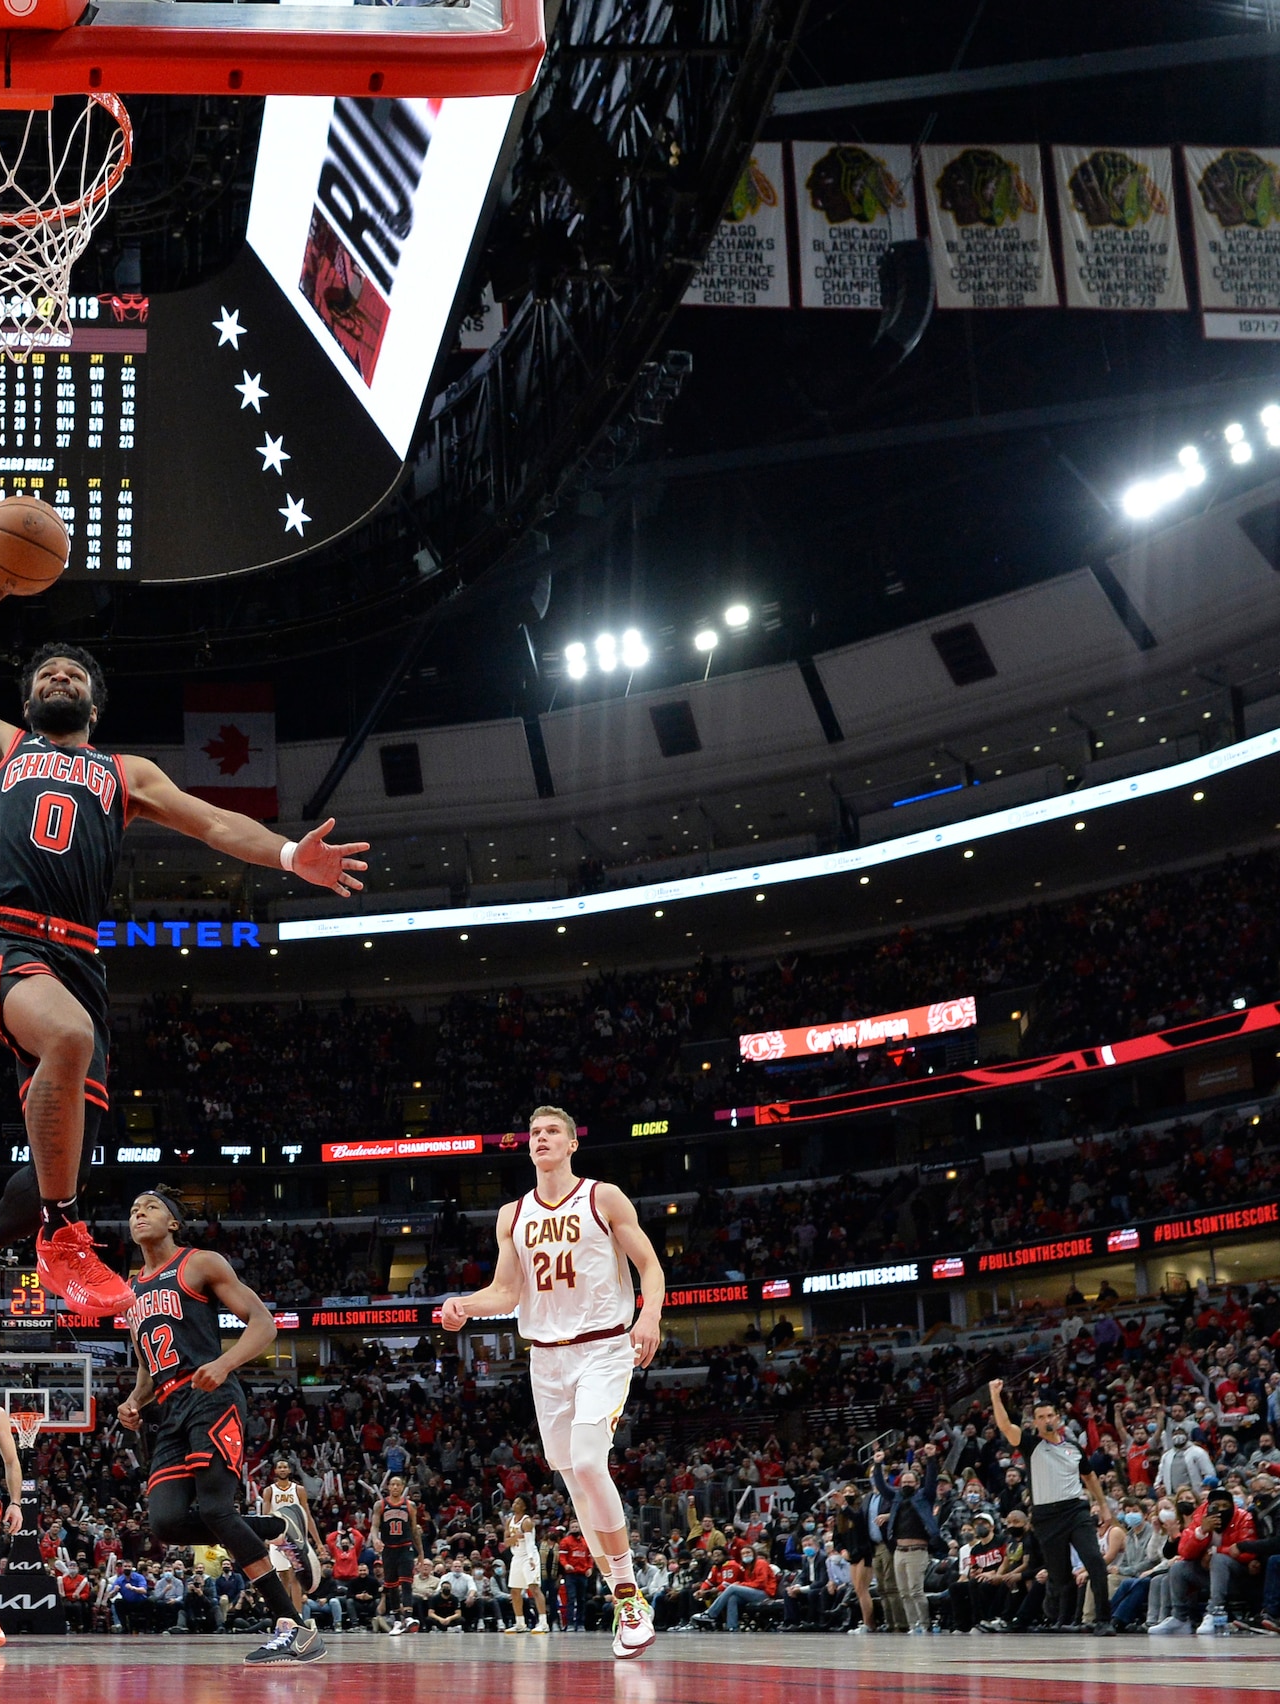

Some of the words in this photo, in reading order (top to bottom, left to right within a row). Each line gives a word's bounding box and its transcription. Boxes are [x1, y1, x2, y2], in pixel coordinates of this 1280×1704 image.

[829, 227, 888, 240] CHICAGO
[961, 227, 1019, 240] CHICAGO
[1091, 229, 1149, 242] CHICAGO
[707, 252, 763, 264] ESTERN
[958, 280, 1038, 293] CHAMPIONS
[1087, 281, 1165, 294] CHAMPIONS
[0, 416, 6, 430] 1
[0, 433, 6, 447] 4
[24, 458, 55, 471] BULLS
[88, 490, 102, 504] 1/4
[1, 750, 117, 815] CHICAGO
[30, 791, 79, 855] 0
[97, 920, 259, 947] ENTER
[631, 1121, 669, 1136] BLOCKS
[11, 1146, 30, 1161] 1:3
[117, 1148, 161, 1162] CHICAGO
[221, 1145, 251, 1156] TIMEOUTS
[282, 1145, 302, 1155] FOULS
[330, 1143, 394, 1159] Budweiser
[398, 1141, 451, 1153] CHAMPIONS
[452, 1139, 476, 1152] CLUB
[1153, 1203, 1279, 1242] #BULLSONTHESCORE
[524, 1214, 581, 1249] CAVS
[979, 1238, 1093, 1271] #BULLSONTHESCORE
[533, 1250, 577, 1292] 24
[802, 1264, 918, 1294] #BULLSONTHESCORE
[10, 1288, 46, 1316] 23
[17, 1319, 53, 1328] TISSOT
[311, 1309, 418, 1327] #BULLSONTHESCORE
[140, 1323, 180, 1377] 12
[275, 1494, 295, 1505] CAVS
[389, 1521, 403, 1536] 11
[9, 1561, 42, 1570] KIA
